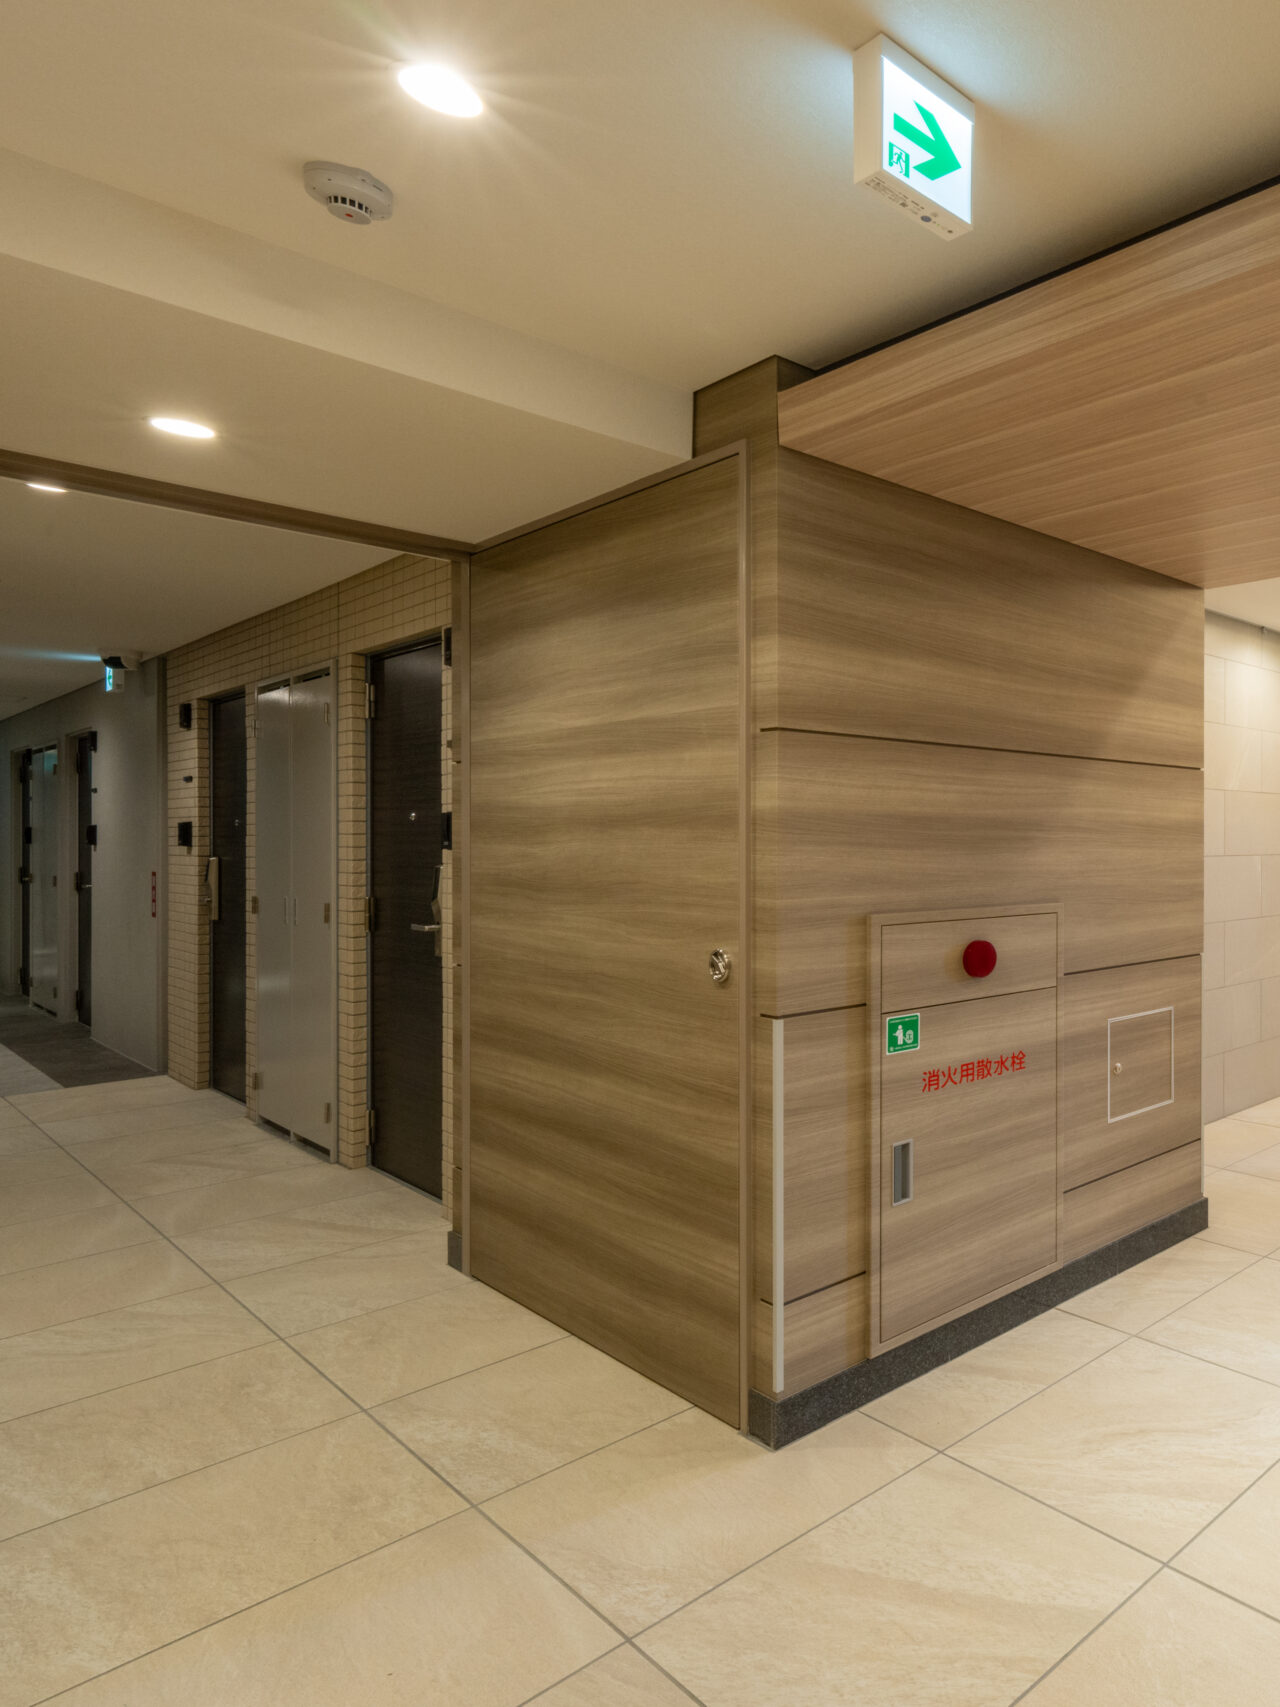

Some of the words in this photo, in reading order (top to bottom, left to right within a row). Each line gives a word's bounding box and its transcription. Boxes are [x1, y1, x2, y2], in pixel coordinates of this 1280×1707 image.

[922, 1050, 1026, 1093] 消火用散水栓
